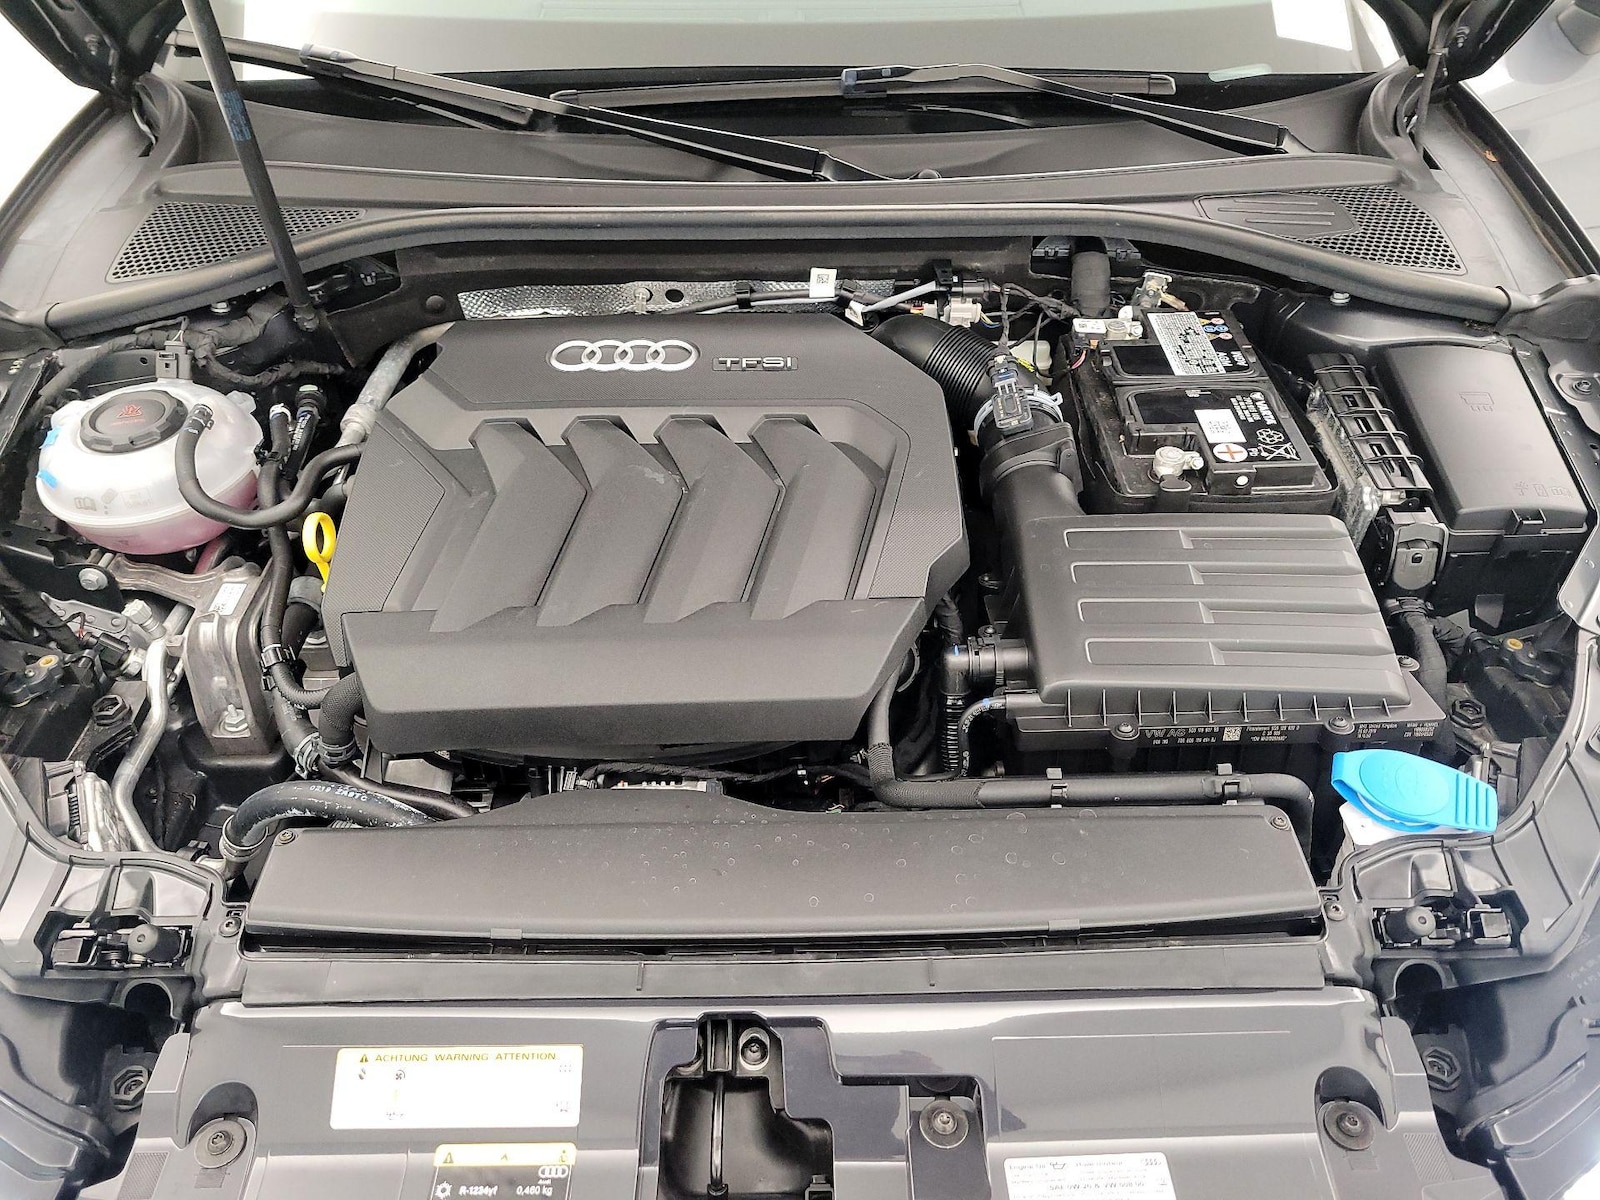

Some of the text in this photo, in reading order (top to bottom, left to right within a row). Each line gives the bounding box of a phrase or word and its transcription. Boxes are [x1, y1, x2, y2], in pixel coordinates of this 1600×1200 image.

[718, 356, 793, 371] TFSI
[1255, 400, 1278, 425] VARTA
[1145, 729, 1167, 739] VW
[1167, 728, 1187, 738] AG
[375, 1052, 557, 1063] ACHTUNG WARNING ATTENTION
[542, 1185, 554, 1197] kg
